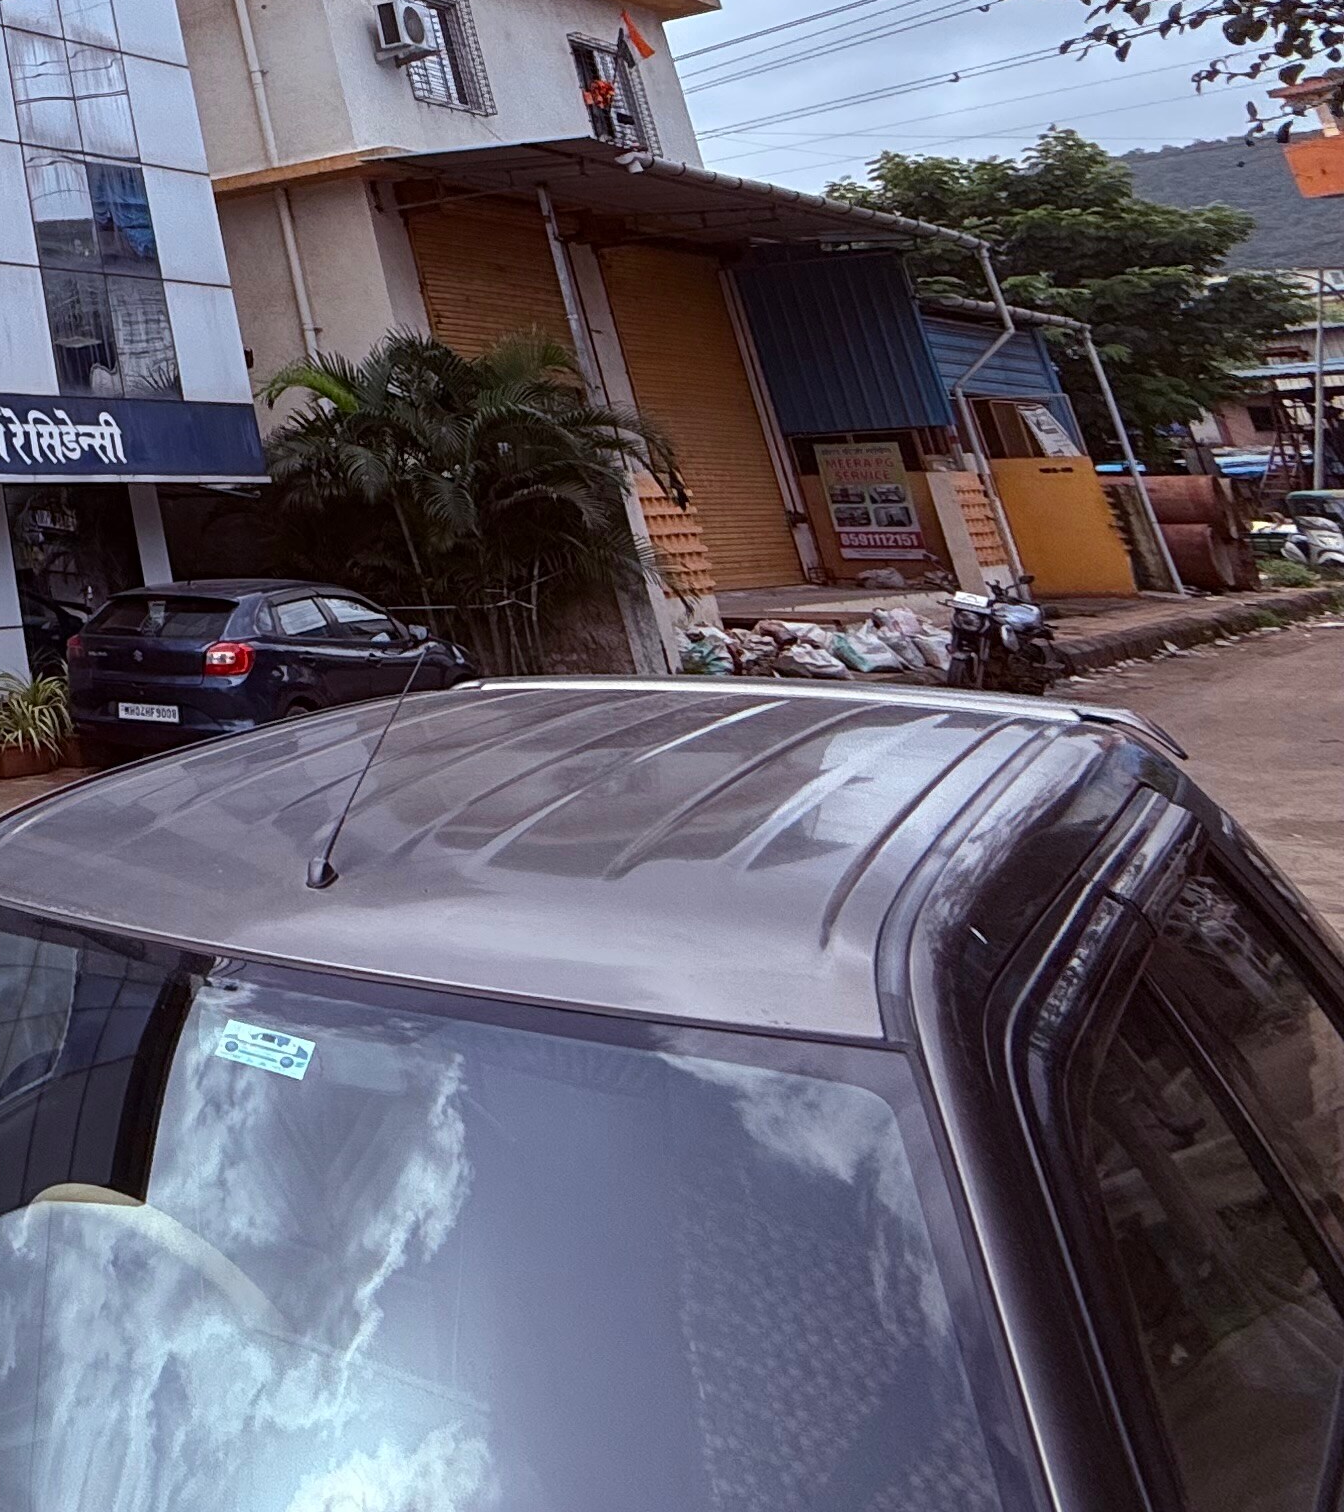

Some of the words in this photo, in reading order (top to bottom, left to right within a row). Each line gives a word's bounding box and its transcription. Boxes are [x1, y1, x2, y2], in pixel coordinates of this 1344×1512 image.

[826, 457, 872, 469] MEERA
[874, 457, 895, 468] PG
[835, 470, 891, 481] SERVICE
